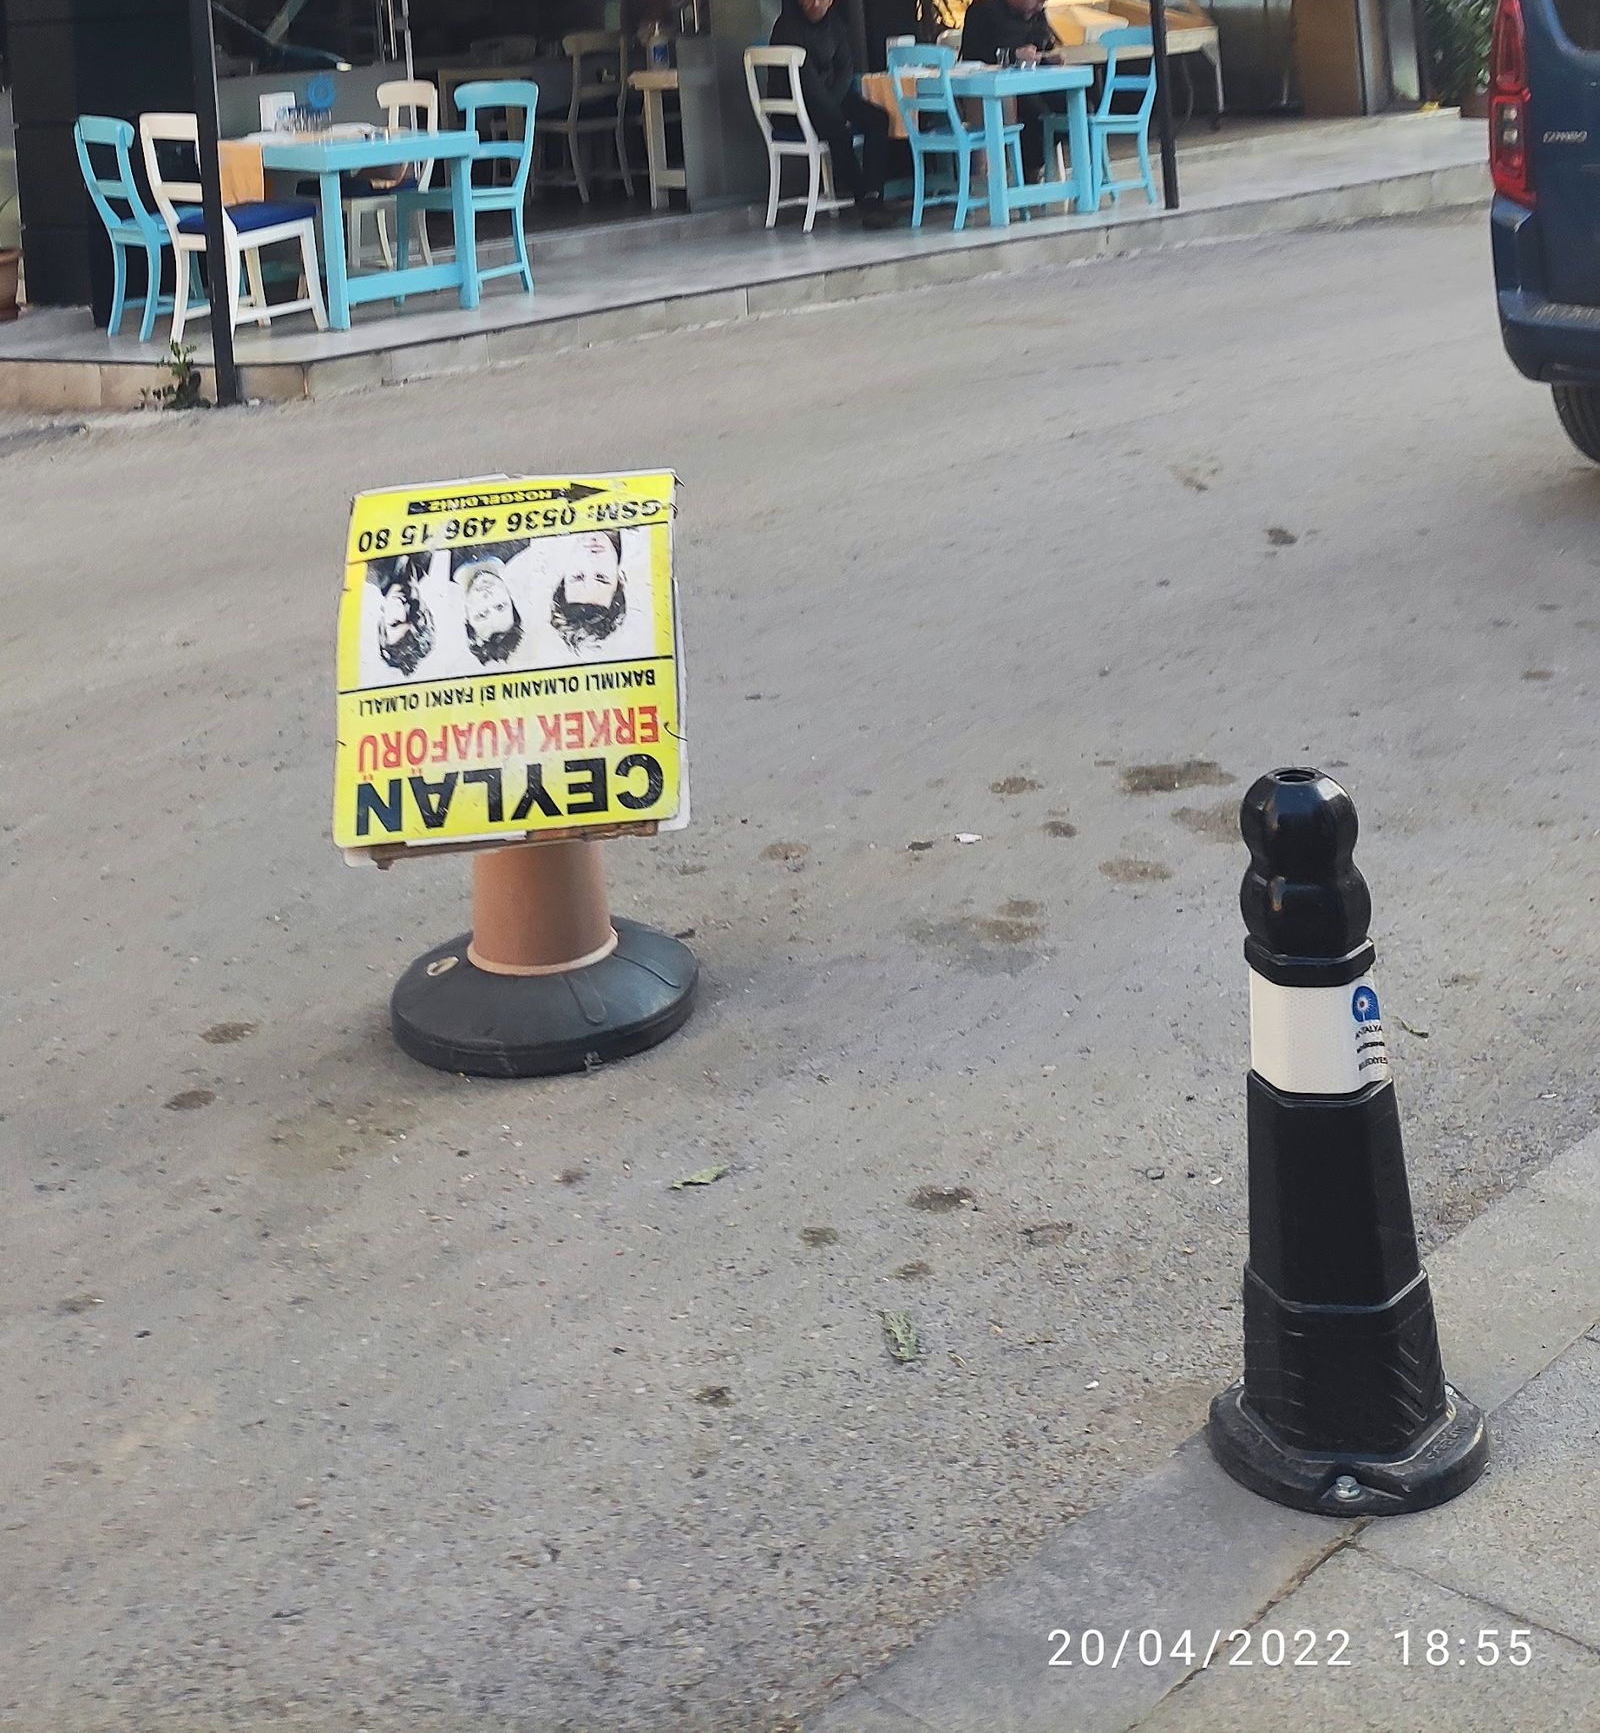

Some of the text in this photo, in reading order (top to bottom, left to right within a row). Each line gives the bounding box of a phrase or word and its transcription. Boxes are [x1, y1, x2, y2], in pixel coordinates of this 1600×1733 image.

[446, 516, 497, 540] 496
[507, 505, 577, 533] 0536
[358, 528, 391, 553] 80
[401, 523, 430, 546] 15
[502, 676, 579, 700] OLMANIN
[586, 669, 656, 693] BAKIMLI
[359, 694, 420, 716] OLMALI
[426, 686, 474, 709] FARKI
[358, 705, 660, 782] ERKEK KUAFÖRÜ
[356, 753, 665, 836] CEYLAN
